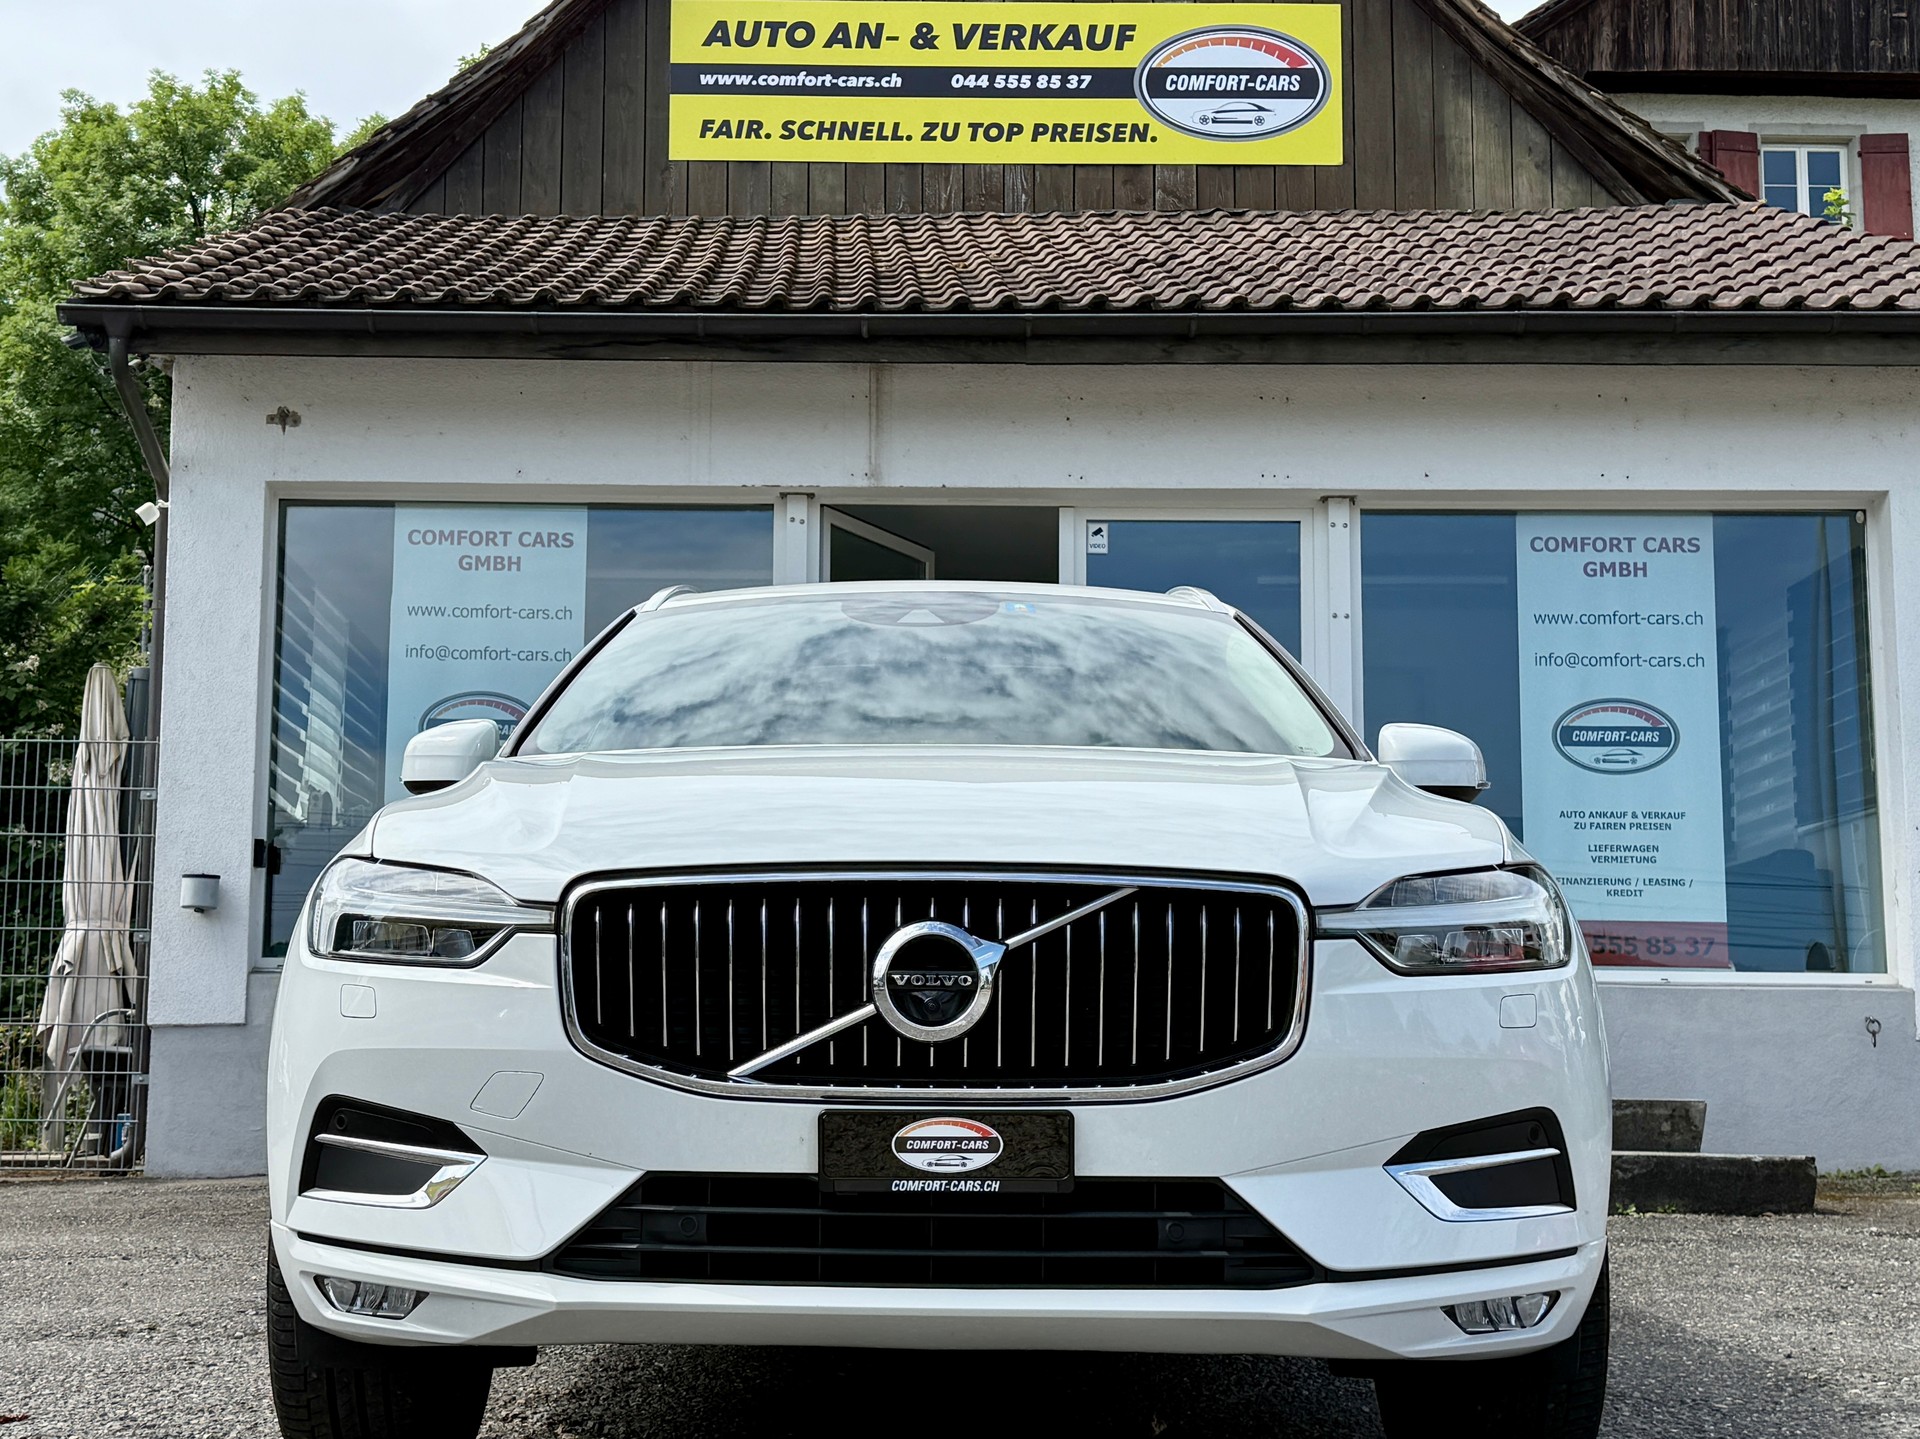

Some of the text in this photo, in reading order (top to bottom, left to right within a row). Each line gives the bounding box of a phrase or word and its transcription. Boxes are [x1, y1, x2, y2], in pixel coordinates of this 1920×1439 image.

[701, 20, 1137, 51] AUTO AN- & VERKAUF
[699, 71, 903, 88] www.comfort-cars.ch
[951, 73, 1093, 89] 044 555 85 37
[1165, 74, 1301, 92] COMFORT-CARS
[699, 119, 1159, 143] FAIR. SCHNELL. ZU TOP PREISEN.
[407, 529, 575, 549] COMFORT CARS
[1529, 536, 1701, 553] COMFORT CARS
[457, 554, 522, 572] GMBH
[1582, 561, 1649, 578] GMBH
[407, 604, 573, 620] www.comfort-cars.ch
[1533, 611, 1704, 626] www.comfort-cars.ch
[405, 644, 572, 662] info@comfort-cars.ch
[1534, 653, 1705, 668] info@comfort-cars.ch
[1572, 730, 1660, 743] COMFORT-CARS
[1559, 810, 1686, 820] AUTO ANKAUF & VERKAUF
[1573, 821, 1672, 831] ZU FAIREN PREISEN
[1588, 844, 1660, 853] LIEFERWAGEN
[1591, 855, 1657, 864] VERMIETUNG
[1643, 878, 1686, 888] LEASING
[1606, 889, 1644, 898] KREDIT
[1592, 934, 1715, 956] 555 85 37
[891, 974, 973, 986] VOLVO
[906, 1139, 989, 1150] COMFORT-CARS
[891, 1180, 1000, 1192] COMFORT-CARS.CH
